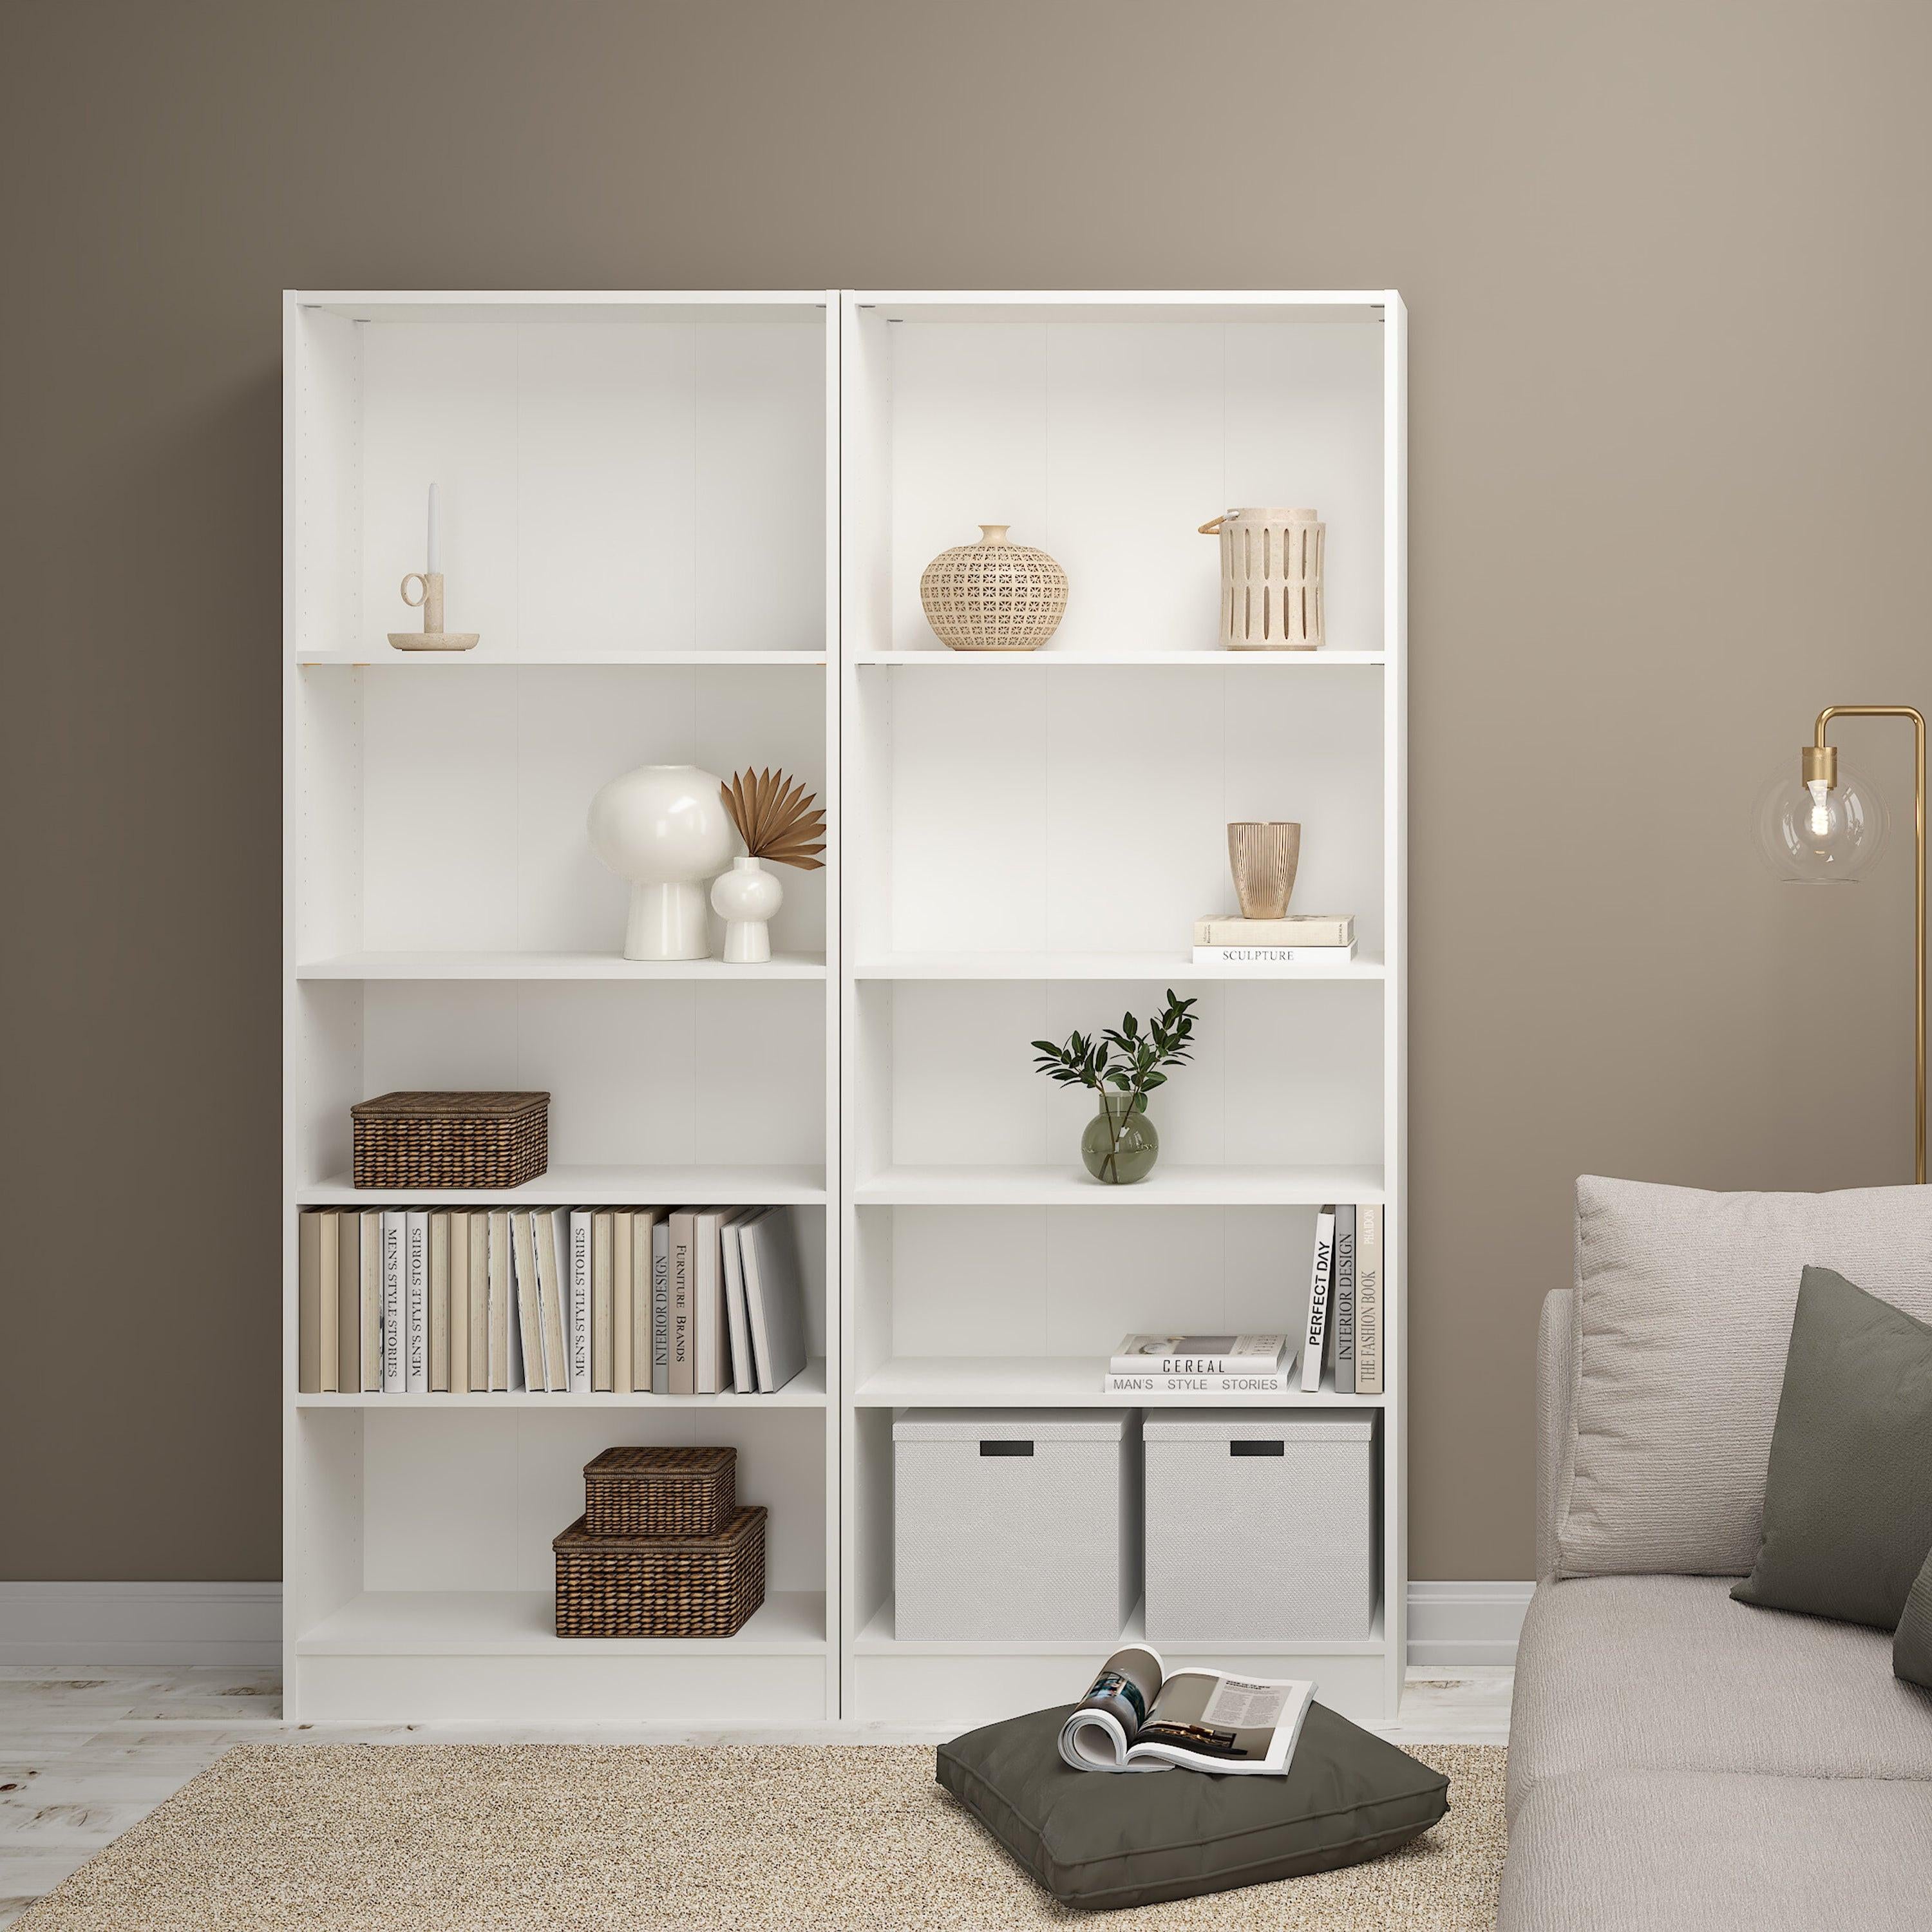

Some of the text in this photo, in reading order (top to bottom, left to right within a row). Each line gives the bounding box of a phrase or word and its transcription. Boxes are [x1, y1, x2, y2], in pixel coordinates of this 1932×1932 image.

[1222, 951, 1294, 961] SCULPTURE
[1363, 1209, 1374, 1244] PHAIDON
[388, 1229, 398, 1378] MEN'S STYLE STORIES
[412, 1228, 422, 1376] MEN'S STYLE STORIES
[575, 1228, 585, 1376] MEN'S STYLE STORIES
[656, 1255, 667, 1366] INTERIOR DESIGN
[676, 1245, 687, 1363] FURNITURE BRANDS
[1309, 1241, 1330, 1345] PERFECT DAY
[1339, 1233, 1352, 1360] INTERIOR DESIGN
[1361, 1271, 1376, 1383] THE FASHION BOOK
[1113, 1378, 1278, 1390] MAN'S STYLE STORIES
[1162, 1359, 1225, 1373] CEREAL
